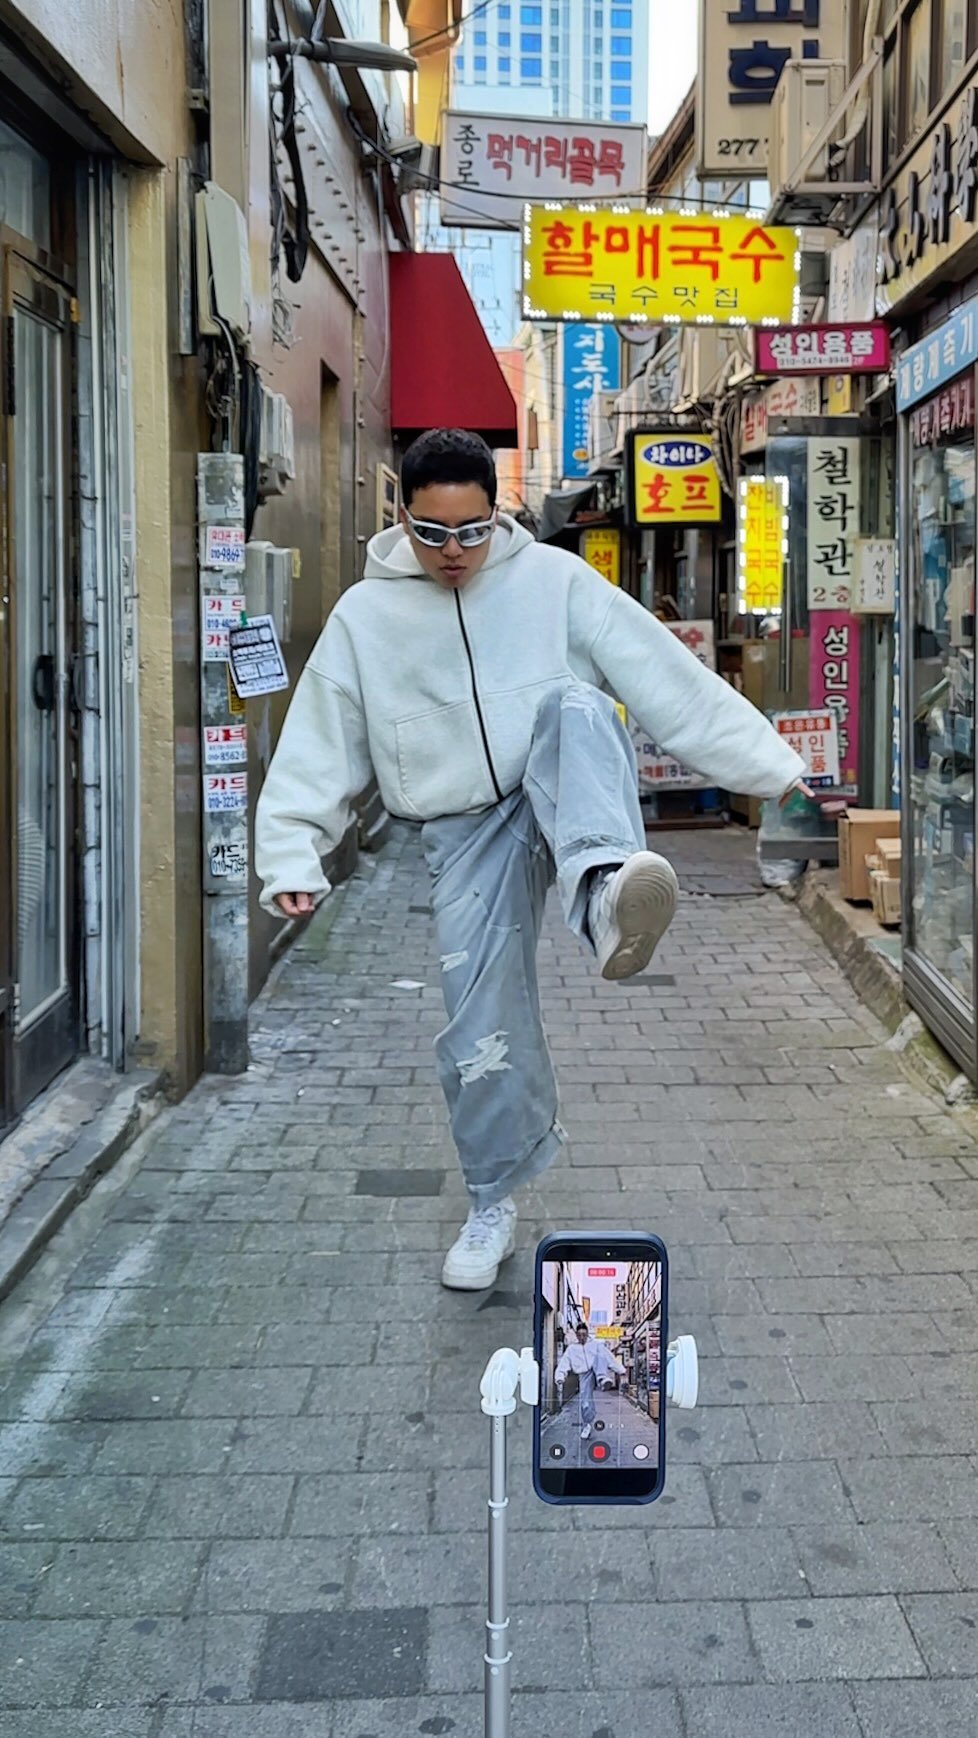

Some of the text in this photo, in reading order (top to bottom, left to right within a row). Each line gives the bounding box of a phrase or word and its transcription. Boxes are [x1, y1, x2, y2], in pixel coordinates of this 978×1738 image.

[450, 124, 481, 187] 종로
[487, 133, 625, 187] 먹거리골목
[541, 220, 785, 283] 할매국수
[769, 331, 875, 358] 성인용품
[642, 473, 715, 514] 호프
[813, 446, 854, 576] 철학관
[208, 777, 244, 790] 카드
[211, 844, 240, 859] 카드
